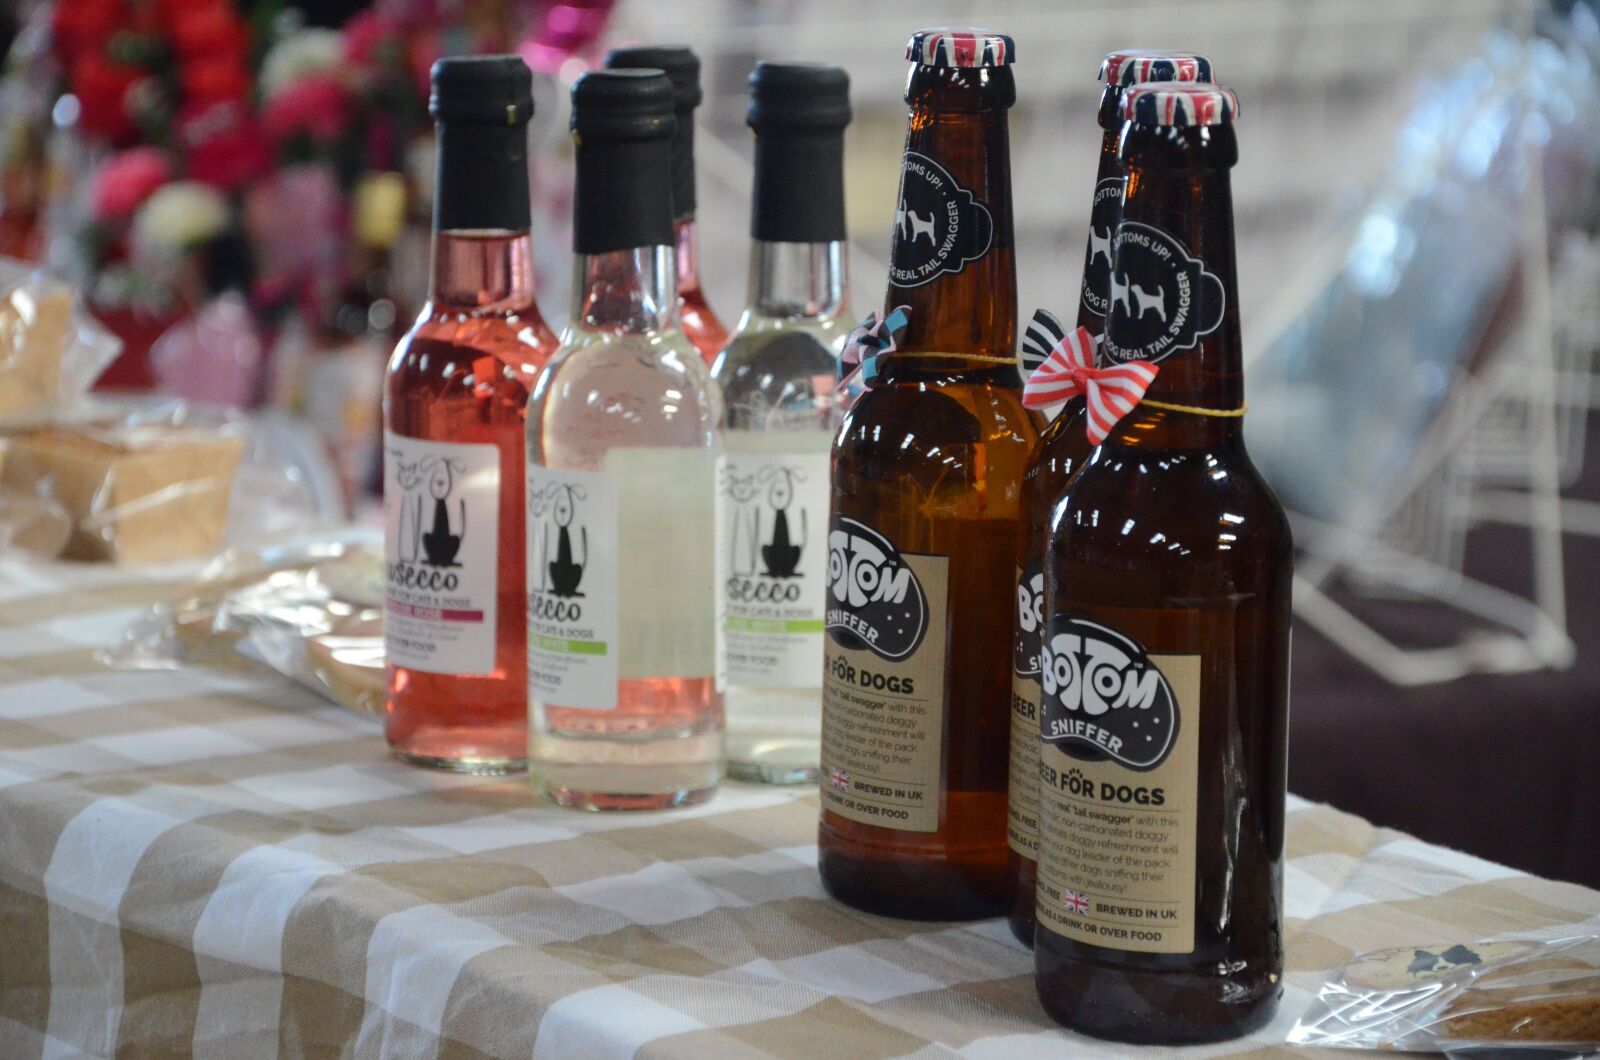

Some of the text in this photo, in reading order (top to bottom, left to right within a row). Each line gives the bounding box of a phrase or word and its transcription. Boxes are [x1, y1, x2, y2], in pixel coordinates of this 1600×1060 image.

[926, 170, 943, 190] UP!
[896, 269, 918, 280] REAL
[918, 259, 941, 276] TAIL
[938, 200, 959, 259] SWAGGER
[1151, 241, 1172, 261] UP!
[1085, 289, 1099, 306] DOG
[1119, 345, 1147, 360] REAL
[1147, 335, 1173, 354] TAIL
[1169, 271, 1191, 335] SWAGGER
[826, 530, 910, 607] OTTOM
[827, 609, 879, 643] SNIFFER
[832, 658, 856, 684] FOR
[860, 669, 914, 695] DOGS
[1042, 633, 1160, 715] BOTTOM
[888, 703, 907, 713] with
[909, 705, 926, 715] this
[878, 740, 893, 749] the
[910, 731, 925, 741] will
[1051, 718, 1123, 754] SNIFFER
[854, 781, 924, 800] BREWED IN UK
[1061, 771, 1095, 799] FOR
[1101, 783, 1165, 806] DOGS
[844, 799, 854, 809] OR
[856, 803, 879, 816] OVER
[881, 808, 909, 820] FOOD
[1136, 816, 1158, 826] with
[1160, 816, 1179, 827] this
[1069, 833, 1097, 847] doggy
[1097, 840, 1158, 855] refreshment
[1161, 846, 1179, 855] will
[1135, 829, 1169, 842] doggy
[1065, 845, 1081, 857] dog
[1082, 848, 1110, 862] leader
[1113, 855, 1123, 865] of
[1125, 856, 1143, 866] the
[1144, 859, 1170, 870] pack
[1080, 863, 1102, 877] dogs
[1104, 868, 1139, 882] sniffing
[1141, 871, 1164, 881] their
[1096, 903, 1143, 918] BREWED
[1145, 909, 1158, 919] IN
[1160, 910, 1177, 920] UK
[1058, 915, 1083, 930] DRINK
[1084, 923, 1098, 933] OR
[1099, 926, 1128, 940] OVER
[1130, 931, 1162, 942] FOOD
